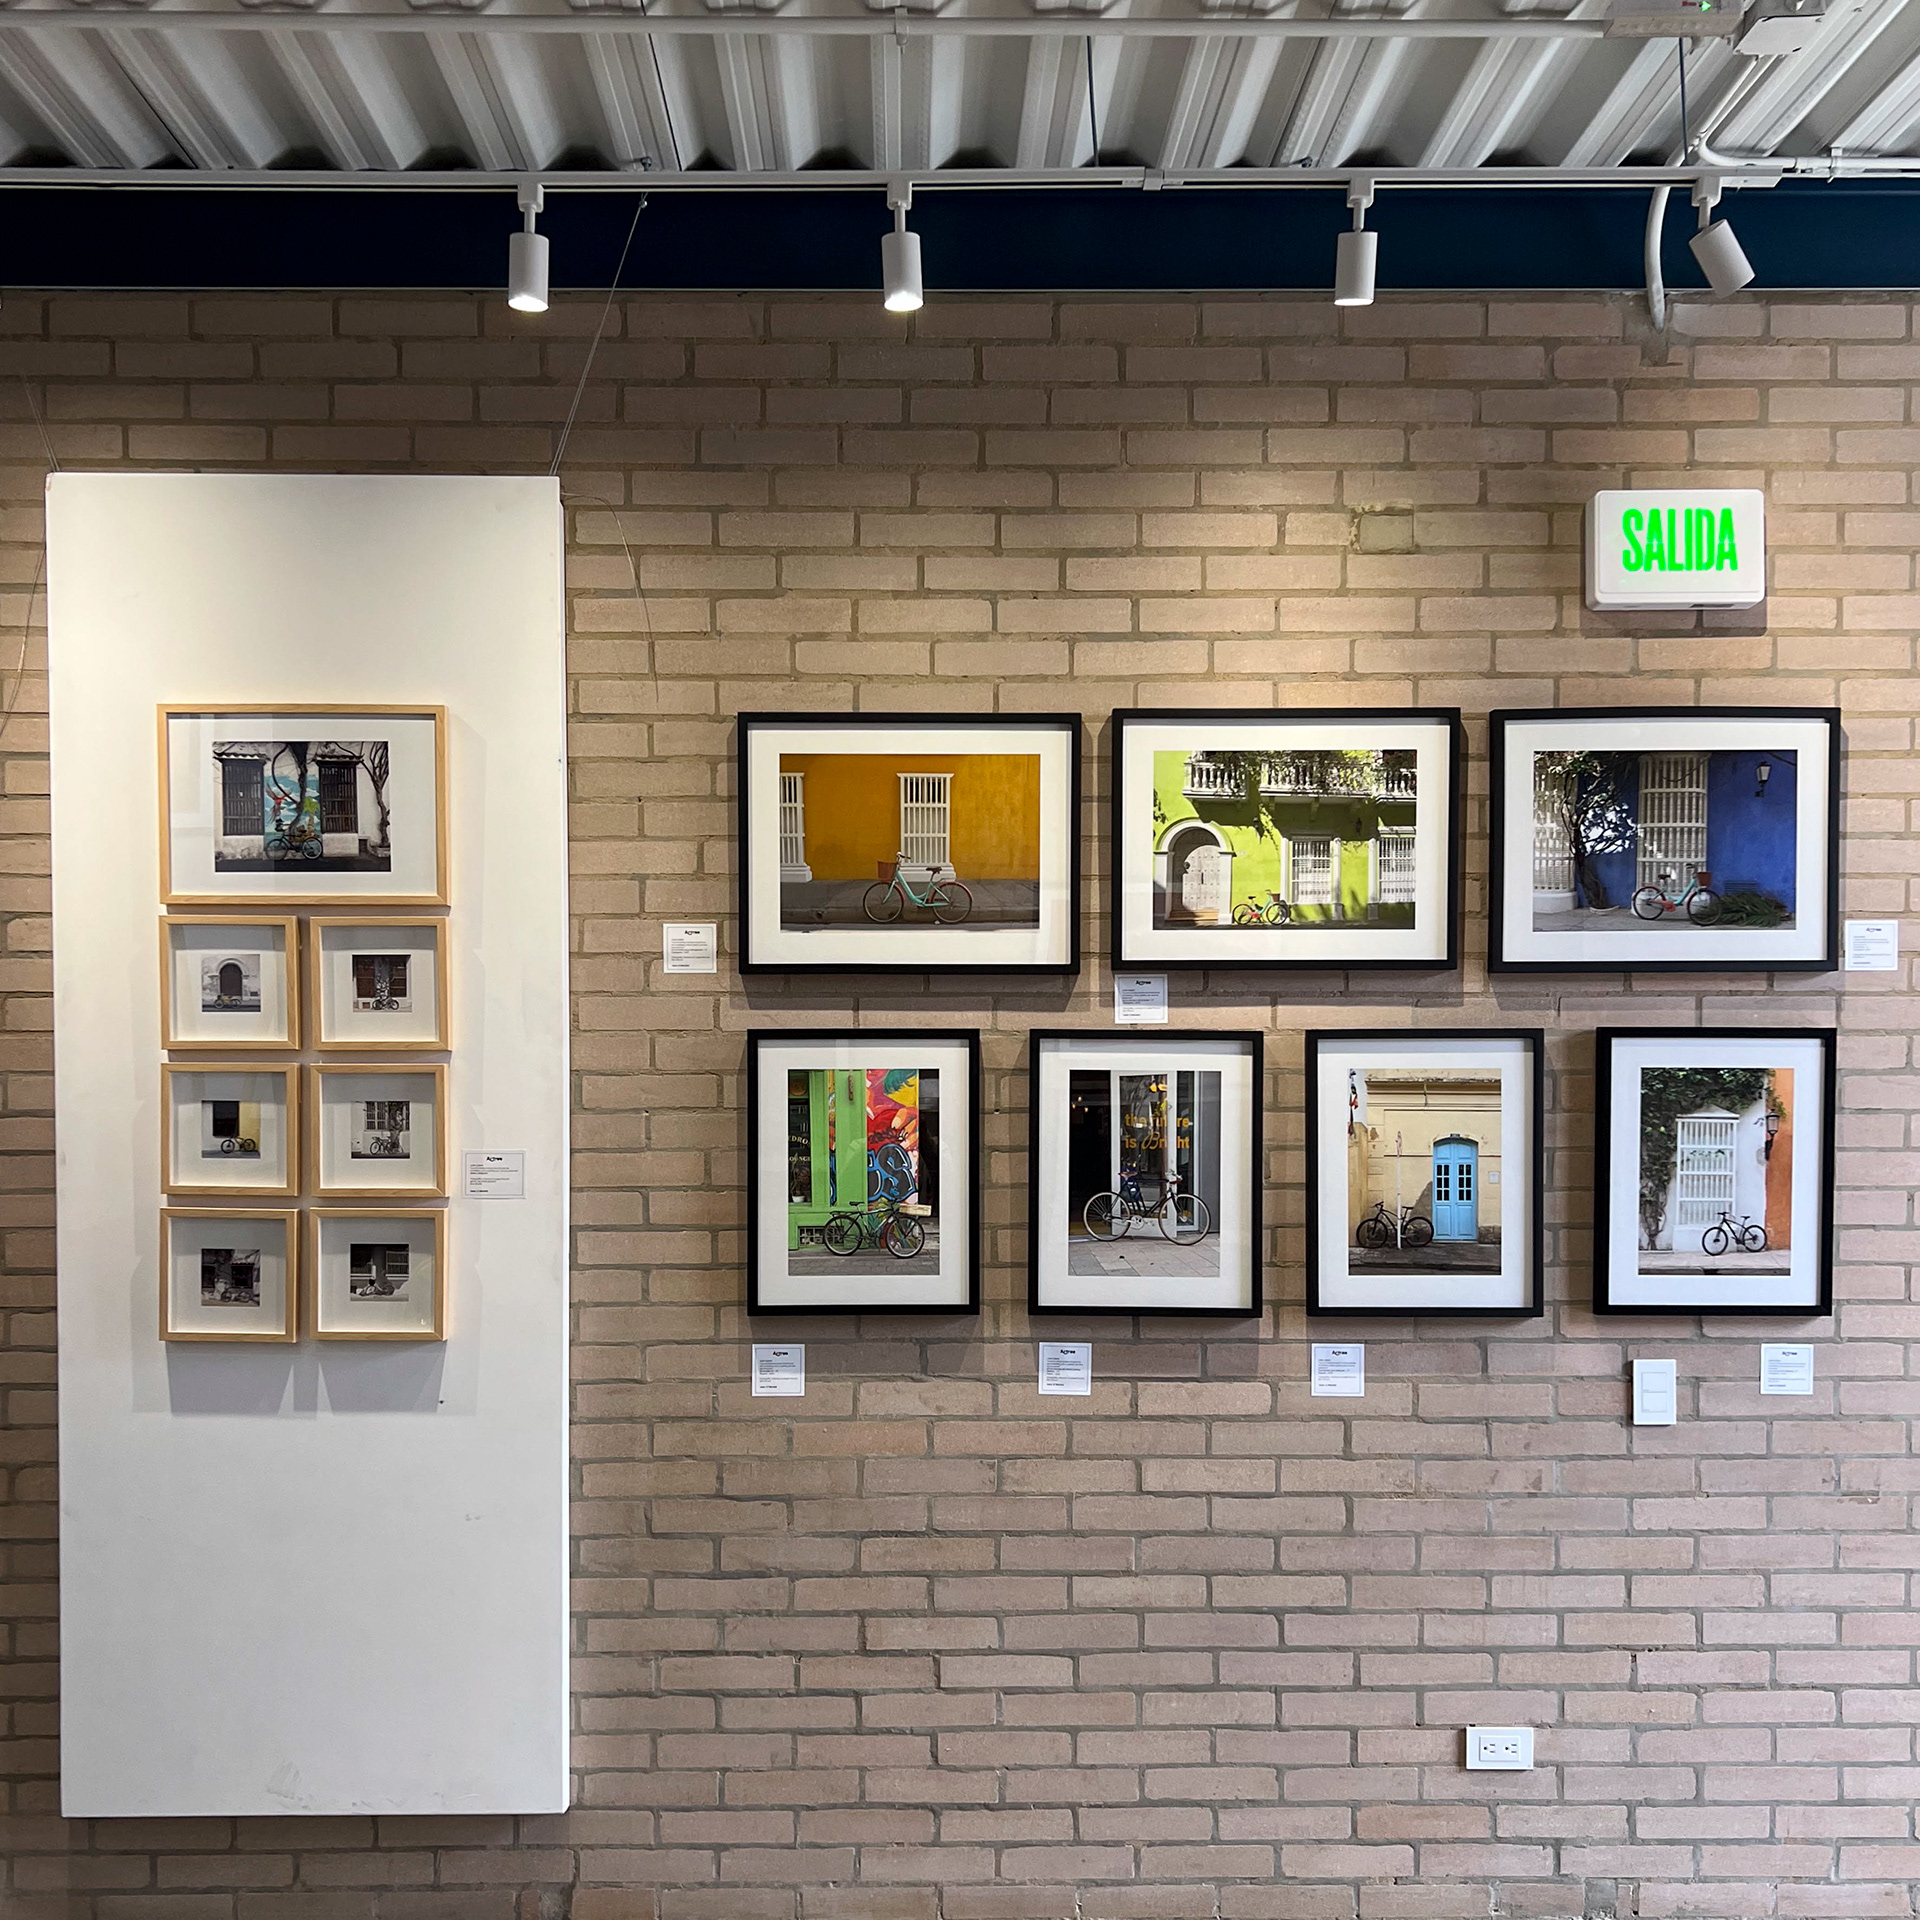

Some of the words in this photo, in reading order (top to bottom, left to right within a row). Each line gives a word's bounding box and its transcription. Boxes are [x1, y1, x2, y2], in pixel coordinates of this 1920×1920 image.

[1622, 507, 1738, 572] SALIDA
[1124, 1113, 1147, 1127] the
[1124, 1133, 1137, 1149] is
[1141, 1131, 1190, 1150] Briht
